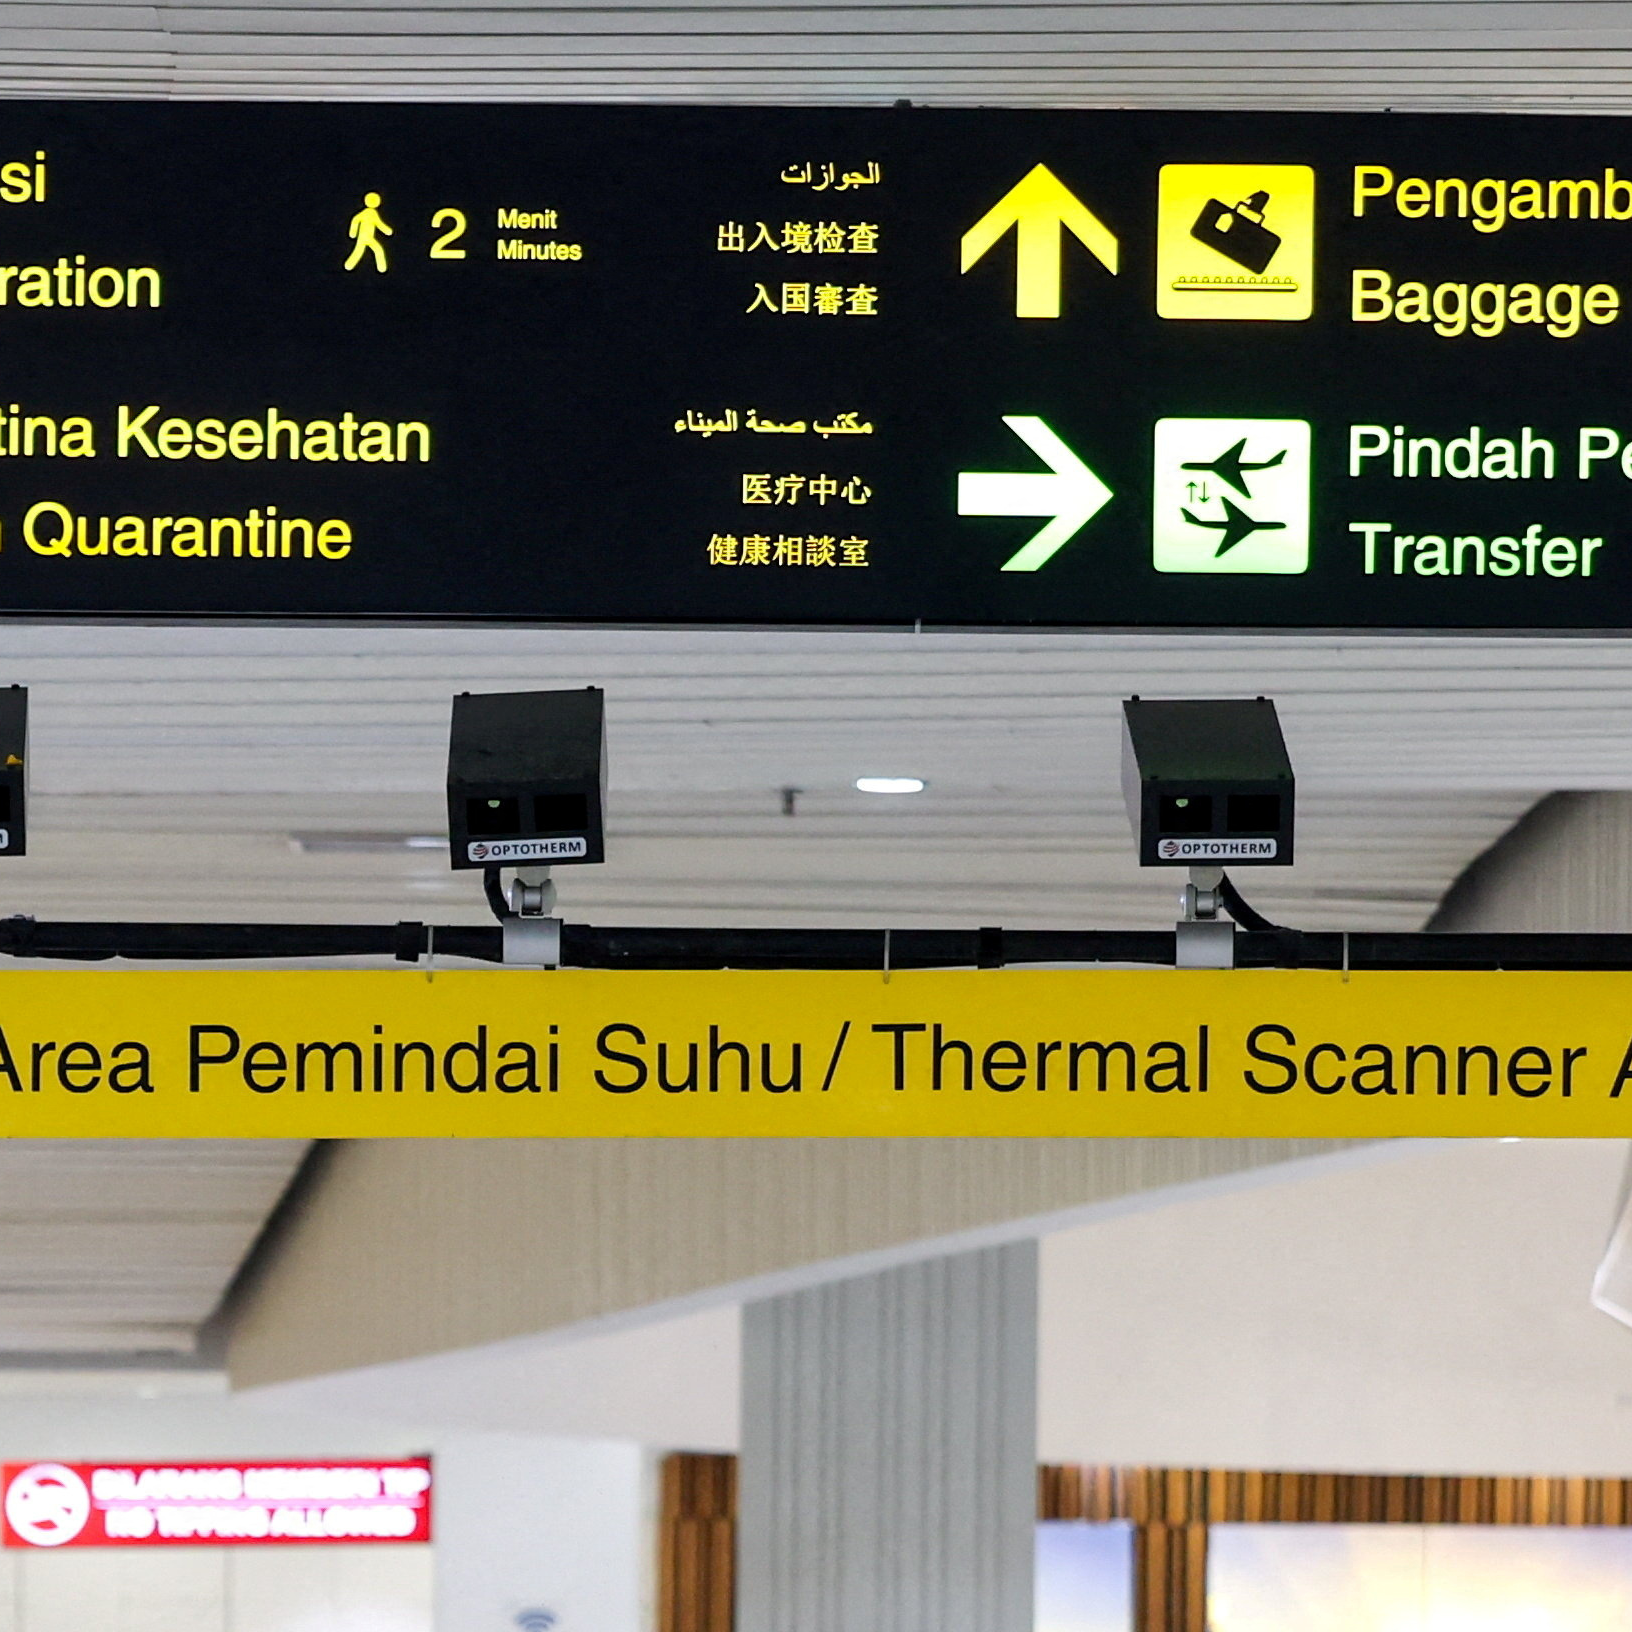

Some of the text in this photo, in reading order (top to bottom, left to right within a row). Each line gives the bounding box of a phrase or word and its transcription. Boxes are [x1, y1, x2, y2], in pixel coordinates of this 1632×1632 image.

[780, 161, 881, 192] الجوازات
[429, 207, 467, 260] 2
[497, 207, 558, 230] Menit
[497, 238, 583, 261] Minutes
[717, 220, 880, 254] 出入境检查
[745, 282, 879, 316] 入国審査
[1351, 269, 1620, 339] Baggage
[117, 405, 430, 463] Kesehatan
[745, 408, 807, 434] صحة
[812, 411, 873, 438] مكتب
[1349, 424, 1555, 480] Pindah
[742, 473, 872, 506] 医疗中心
[22, 501, 353, 560] Quarantine
[706, 533, 869, 567] 健康相談室
[1348, 522, 1603, 578] Transfer
[490, 838, 584, 859] OPTOTHERM
[1180, 841, 1275, 860] OPTOTHERM
[189, 1024, 559, 1094] Pemindai
[594, 1022, 802, 1094] Suhu
[821, 1020, 851, 1092] /
[871, 1023, 1209, 1093] Thermal
[1243, 1023, 1588, 1098] Scanner
